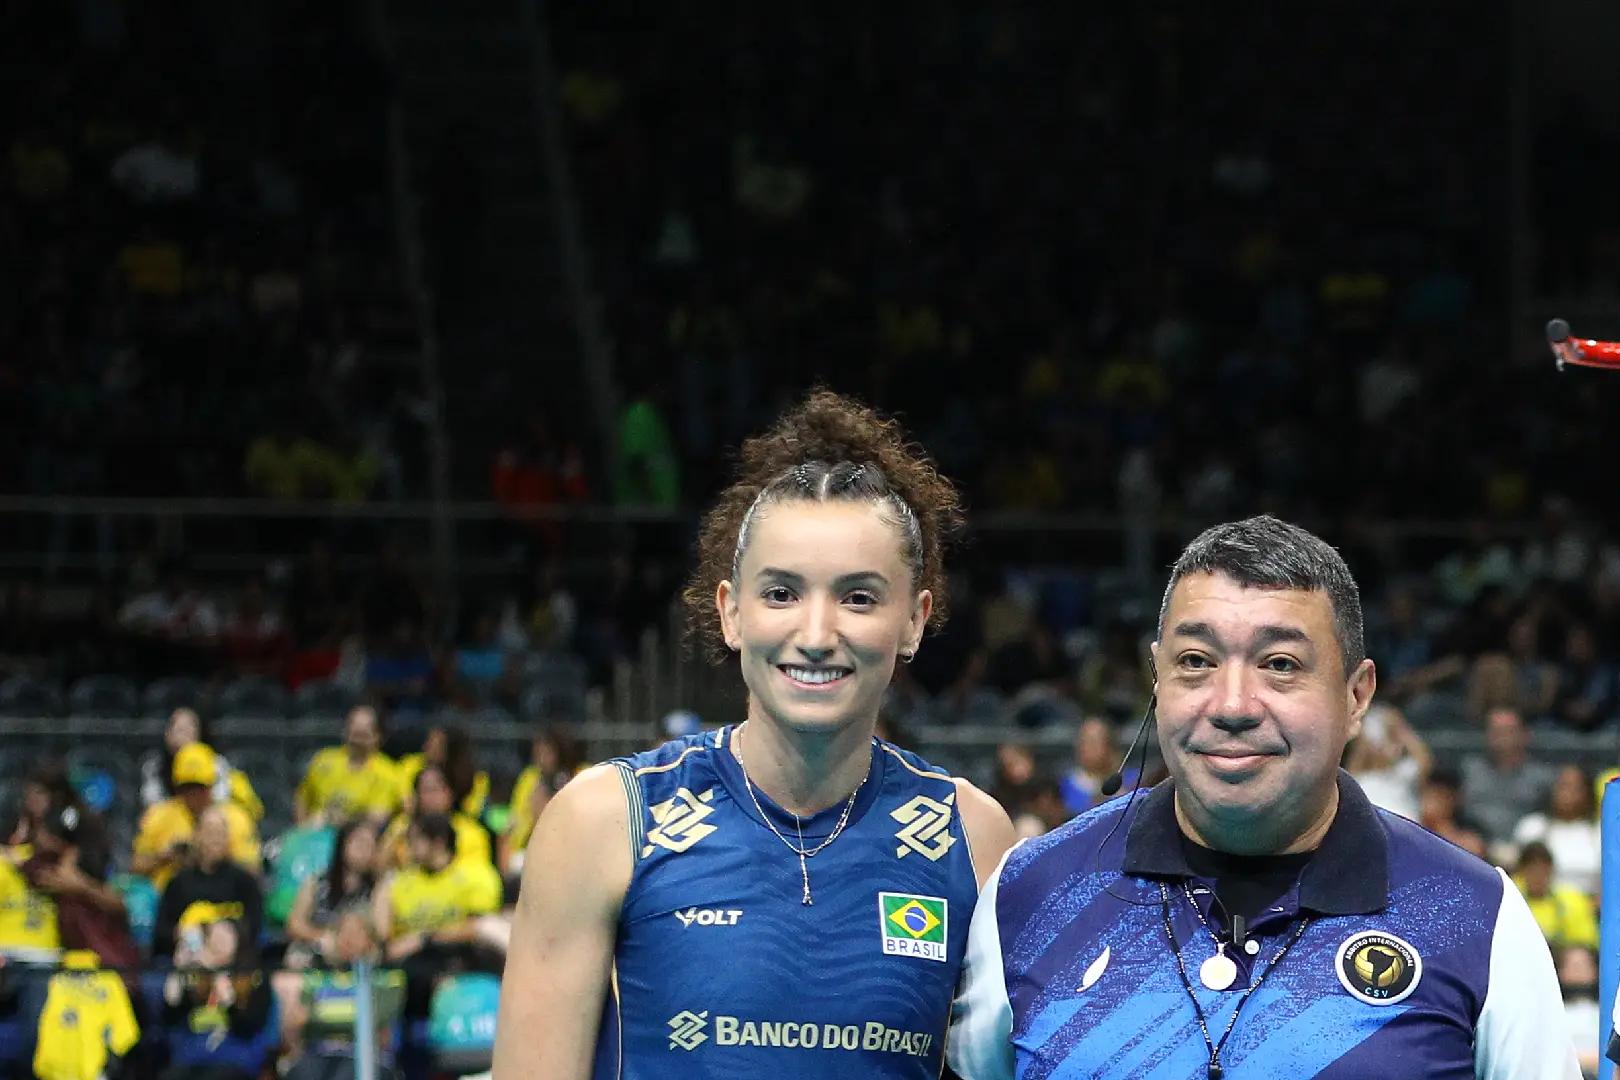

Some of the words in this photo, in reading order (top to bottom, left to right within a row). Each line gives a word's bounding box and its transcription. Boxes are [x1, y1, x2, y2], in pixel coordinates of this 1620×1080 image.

[674, 907, 743, 928] VOLT
[886, 939, 945, 959] BRASIL
[1364, 987, 1389, 998] CSV
[715, 1016, 818, 1049] BANCO
[822, 1024, 860, 1051] DO
[862, 1021, 932, 1057] BRASIL
